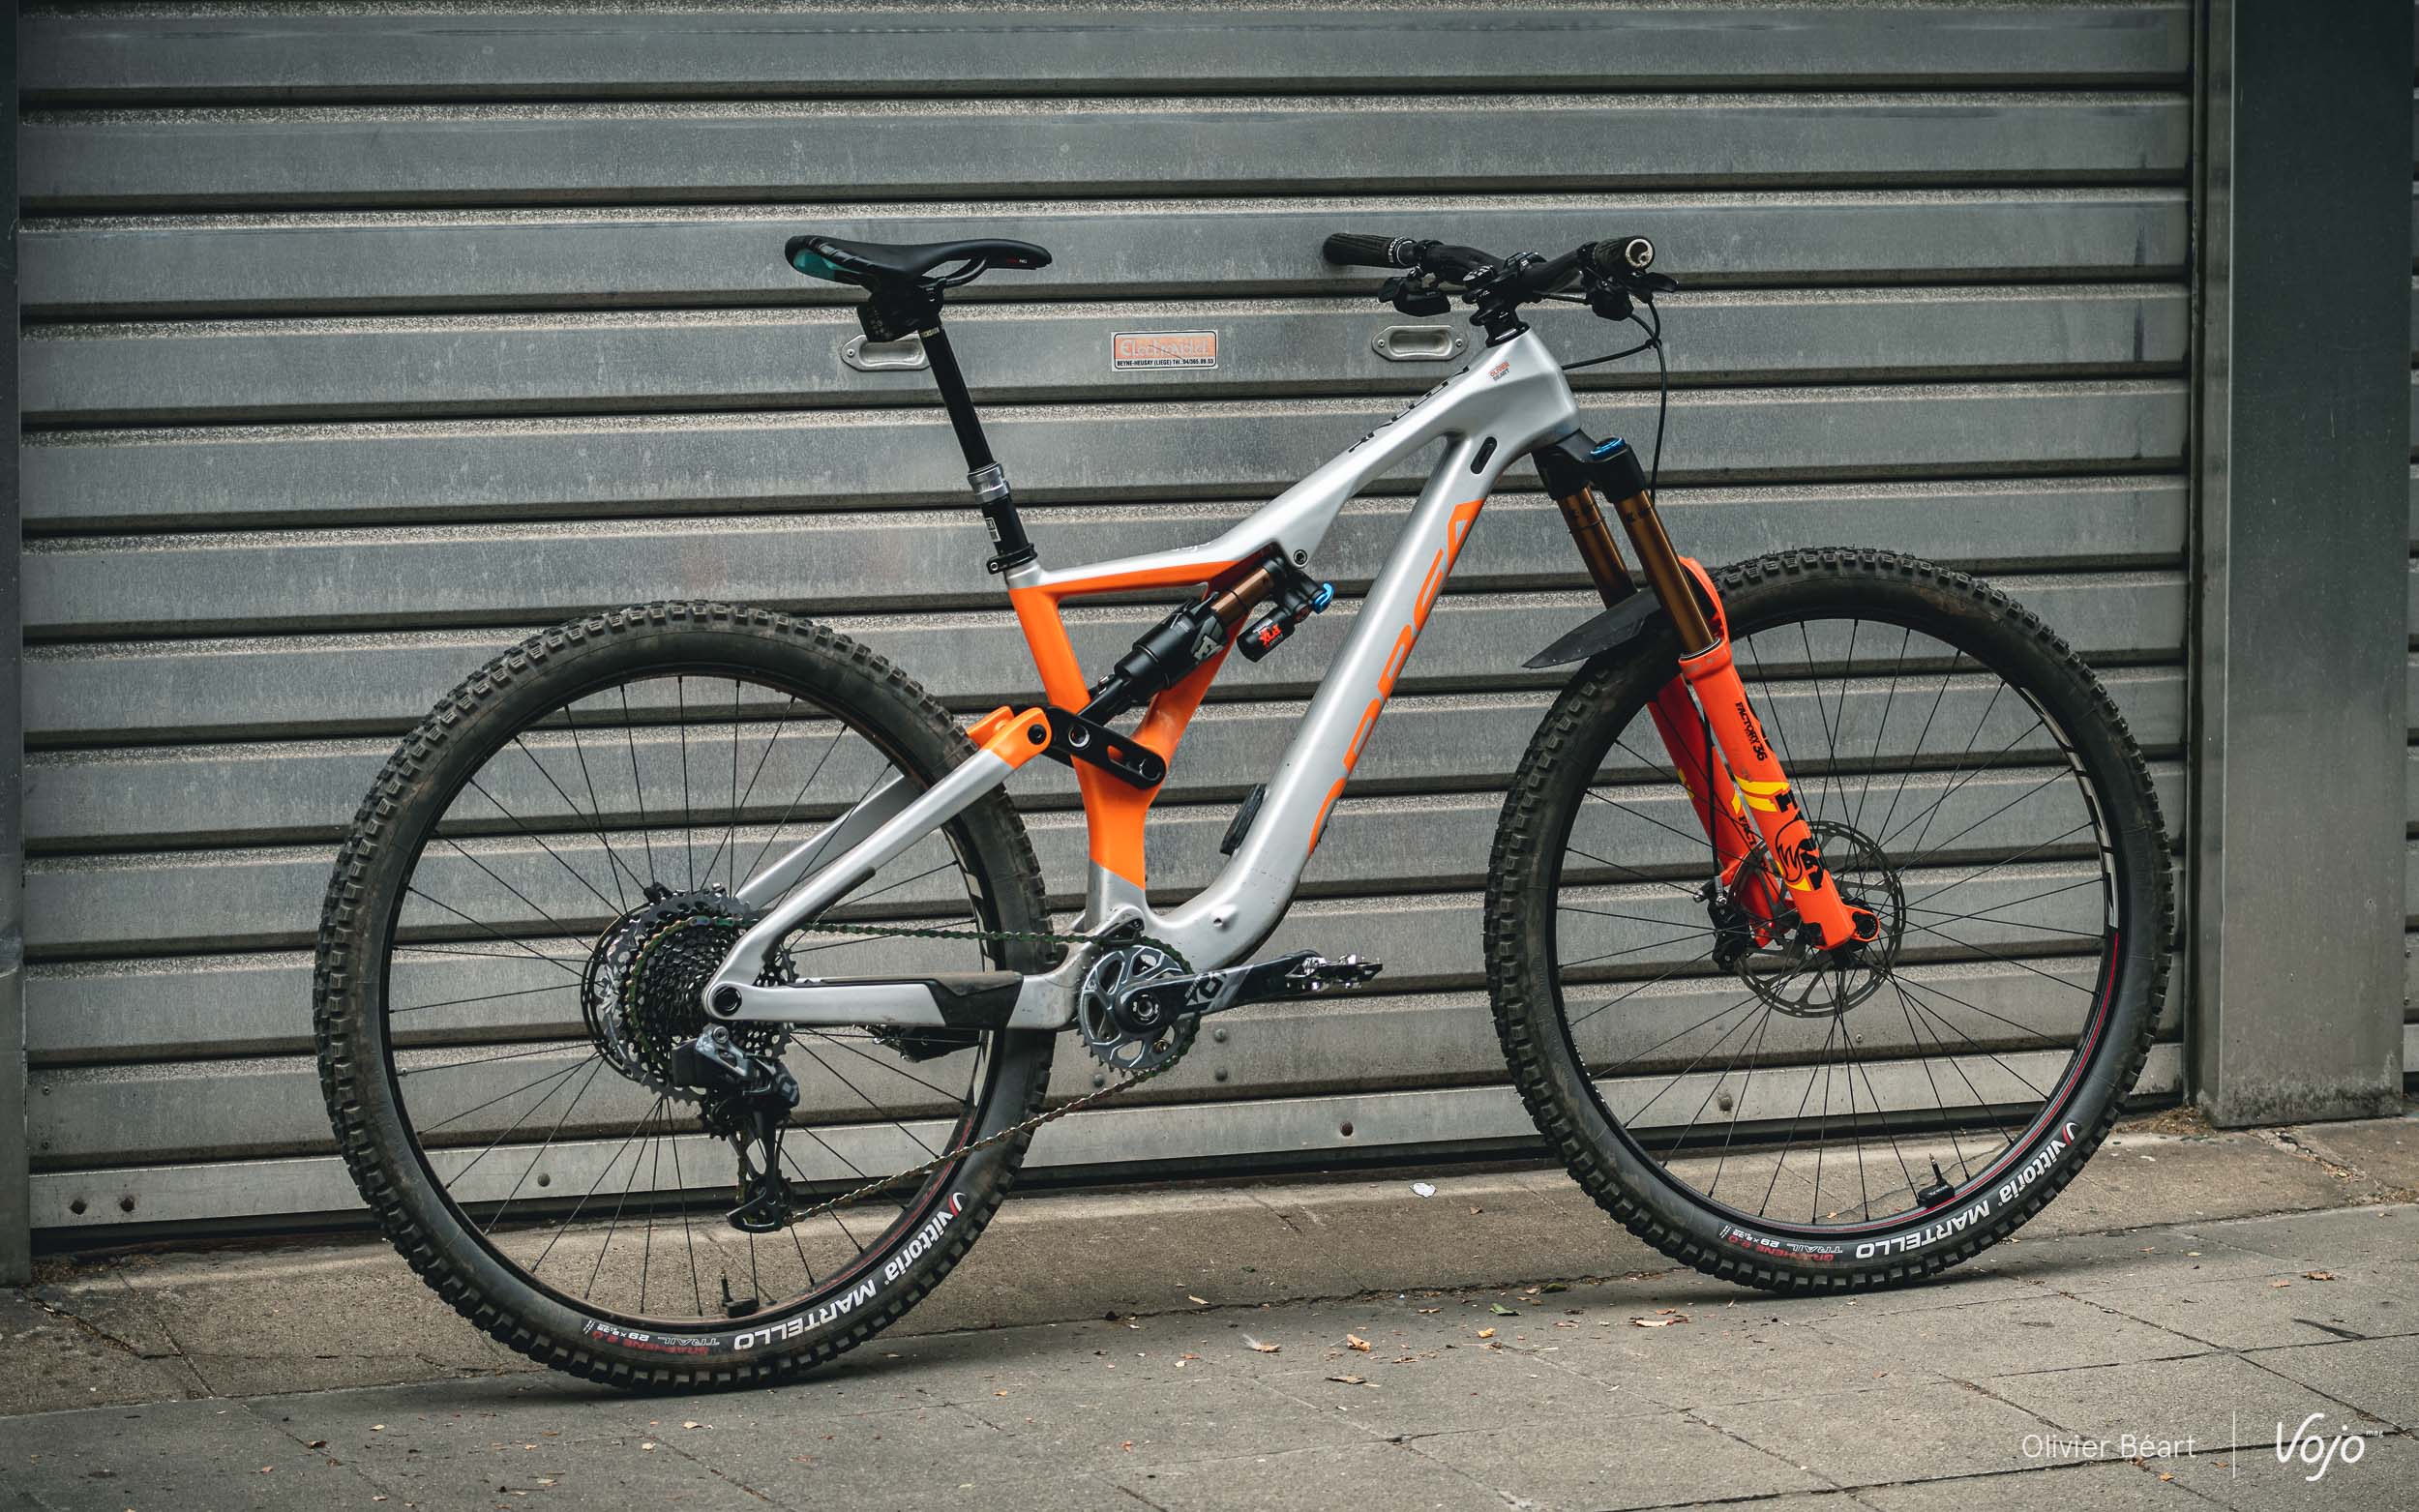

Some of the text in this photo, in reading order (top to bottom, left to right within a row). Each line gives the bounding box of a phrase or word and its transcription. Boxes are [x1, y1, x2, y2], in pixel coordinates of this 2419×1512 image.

[1735, 700, 1761, 745] FACTORY
[1752, 743, 1768, 761] 36
[1786, 1243, 1843, 1254] TRAIL
[1855, 1200, 1990, 1259] MARTELLO
[658, 1336, 720, 1347] TRAIL
[733, 1279, 877, 1350] MARTELLO
